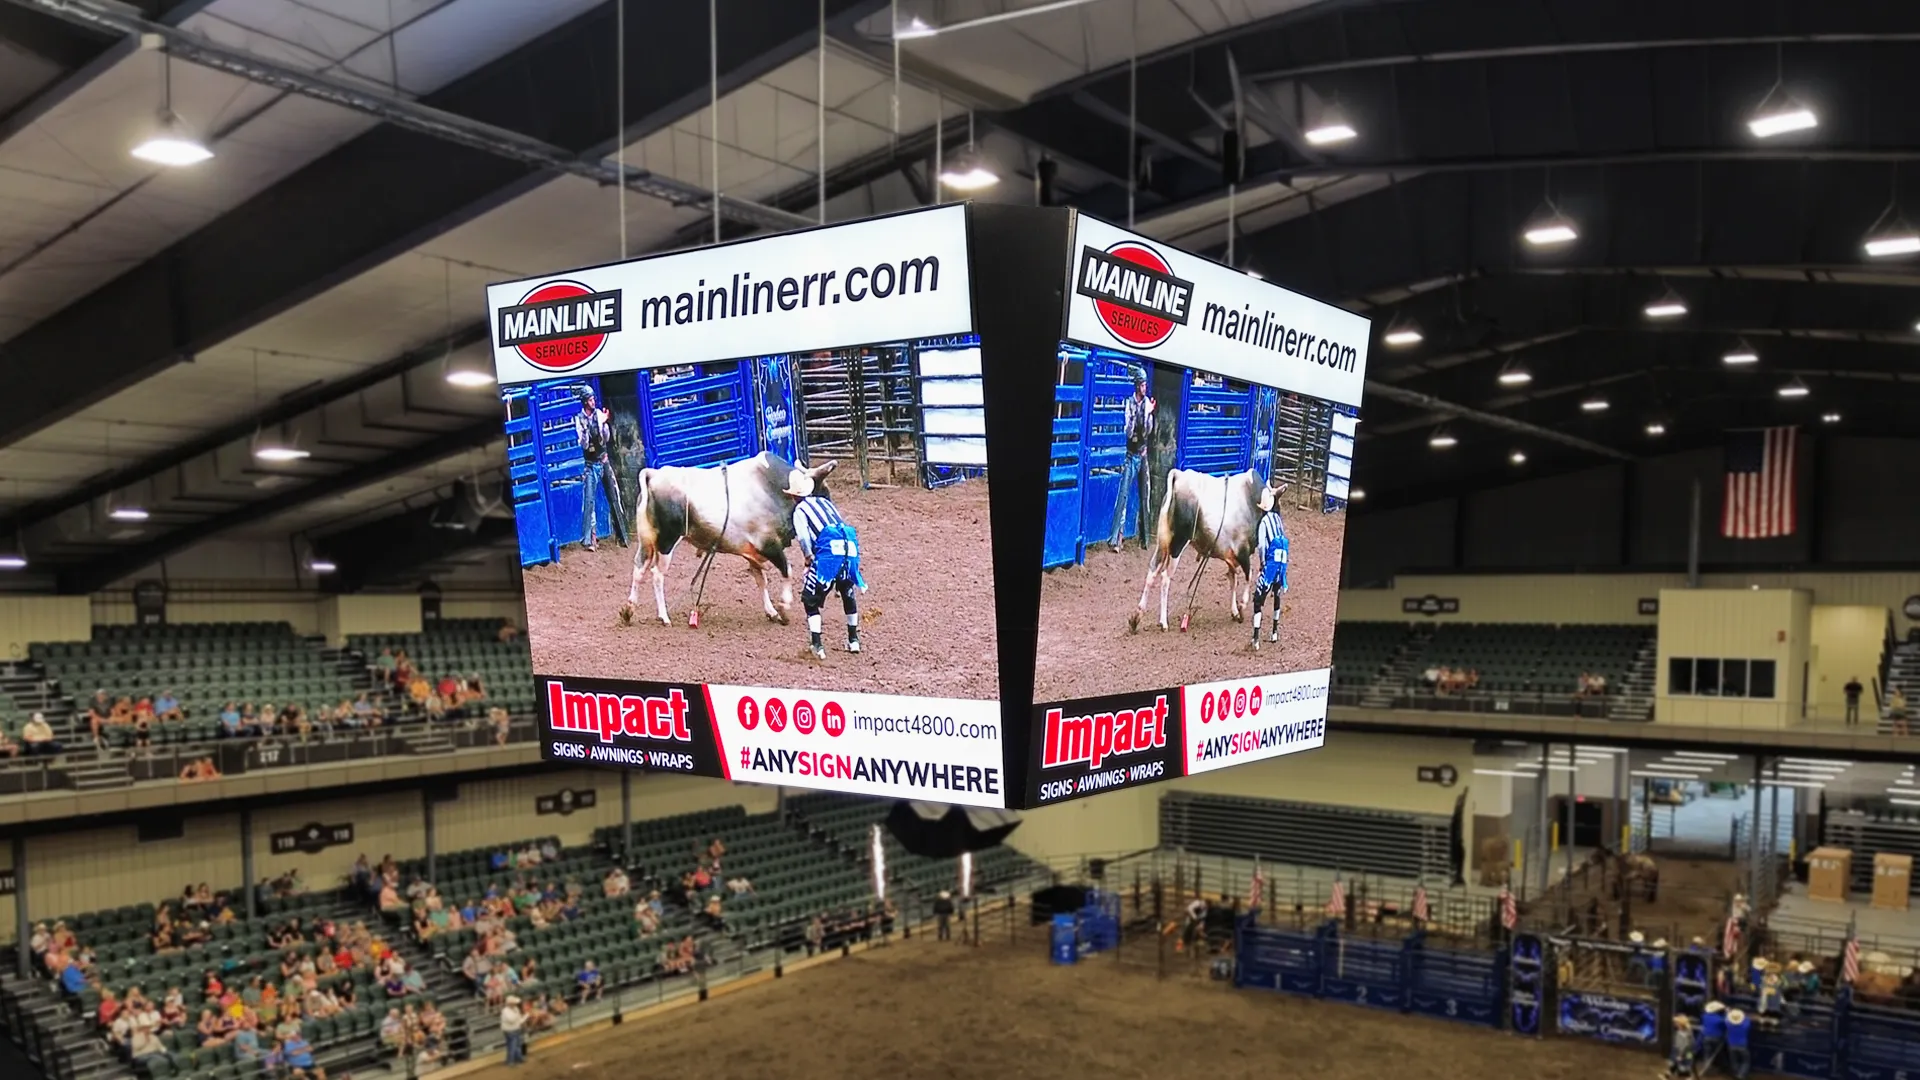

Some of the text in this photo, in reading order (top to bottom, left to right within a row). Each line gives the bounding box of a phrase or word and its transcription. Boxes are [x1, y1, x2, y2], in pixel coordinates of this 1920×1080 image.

[641, 255, 940, 329] mainlinerr.com
[1084, 256, 1188, 318] MAINLINE
[503, 297, 615, 341] MAINLINE
[1111, 310, 1159, 336] SERVICES
[1202, 301, 1357, 373] mainlinerr.com
[535, 340, 589, 359] SERVICES
[547, 681, 692, 743] Impact
[1265, 684, 1327, 709] impact4800.com
[853, 710, 998, 741] impact4800.com
[1042, 694, 1169, 770] Impact
[1196, 717, 1324, 762] #ANYSIGNANYWHERE
[553, 742, 694, 771] SIGNS AWNINGS WRAPS
[740, 746, 999, 795] #ANYSIGNANYWHERE
[1040, 761, 1164, 800] SIGNS AWNINGS WRAPS
[1356, 986, 1368, 1004] 2
[1446, 1000, 1457, 1016] 3
